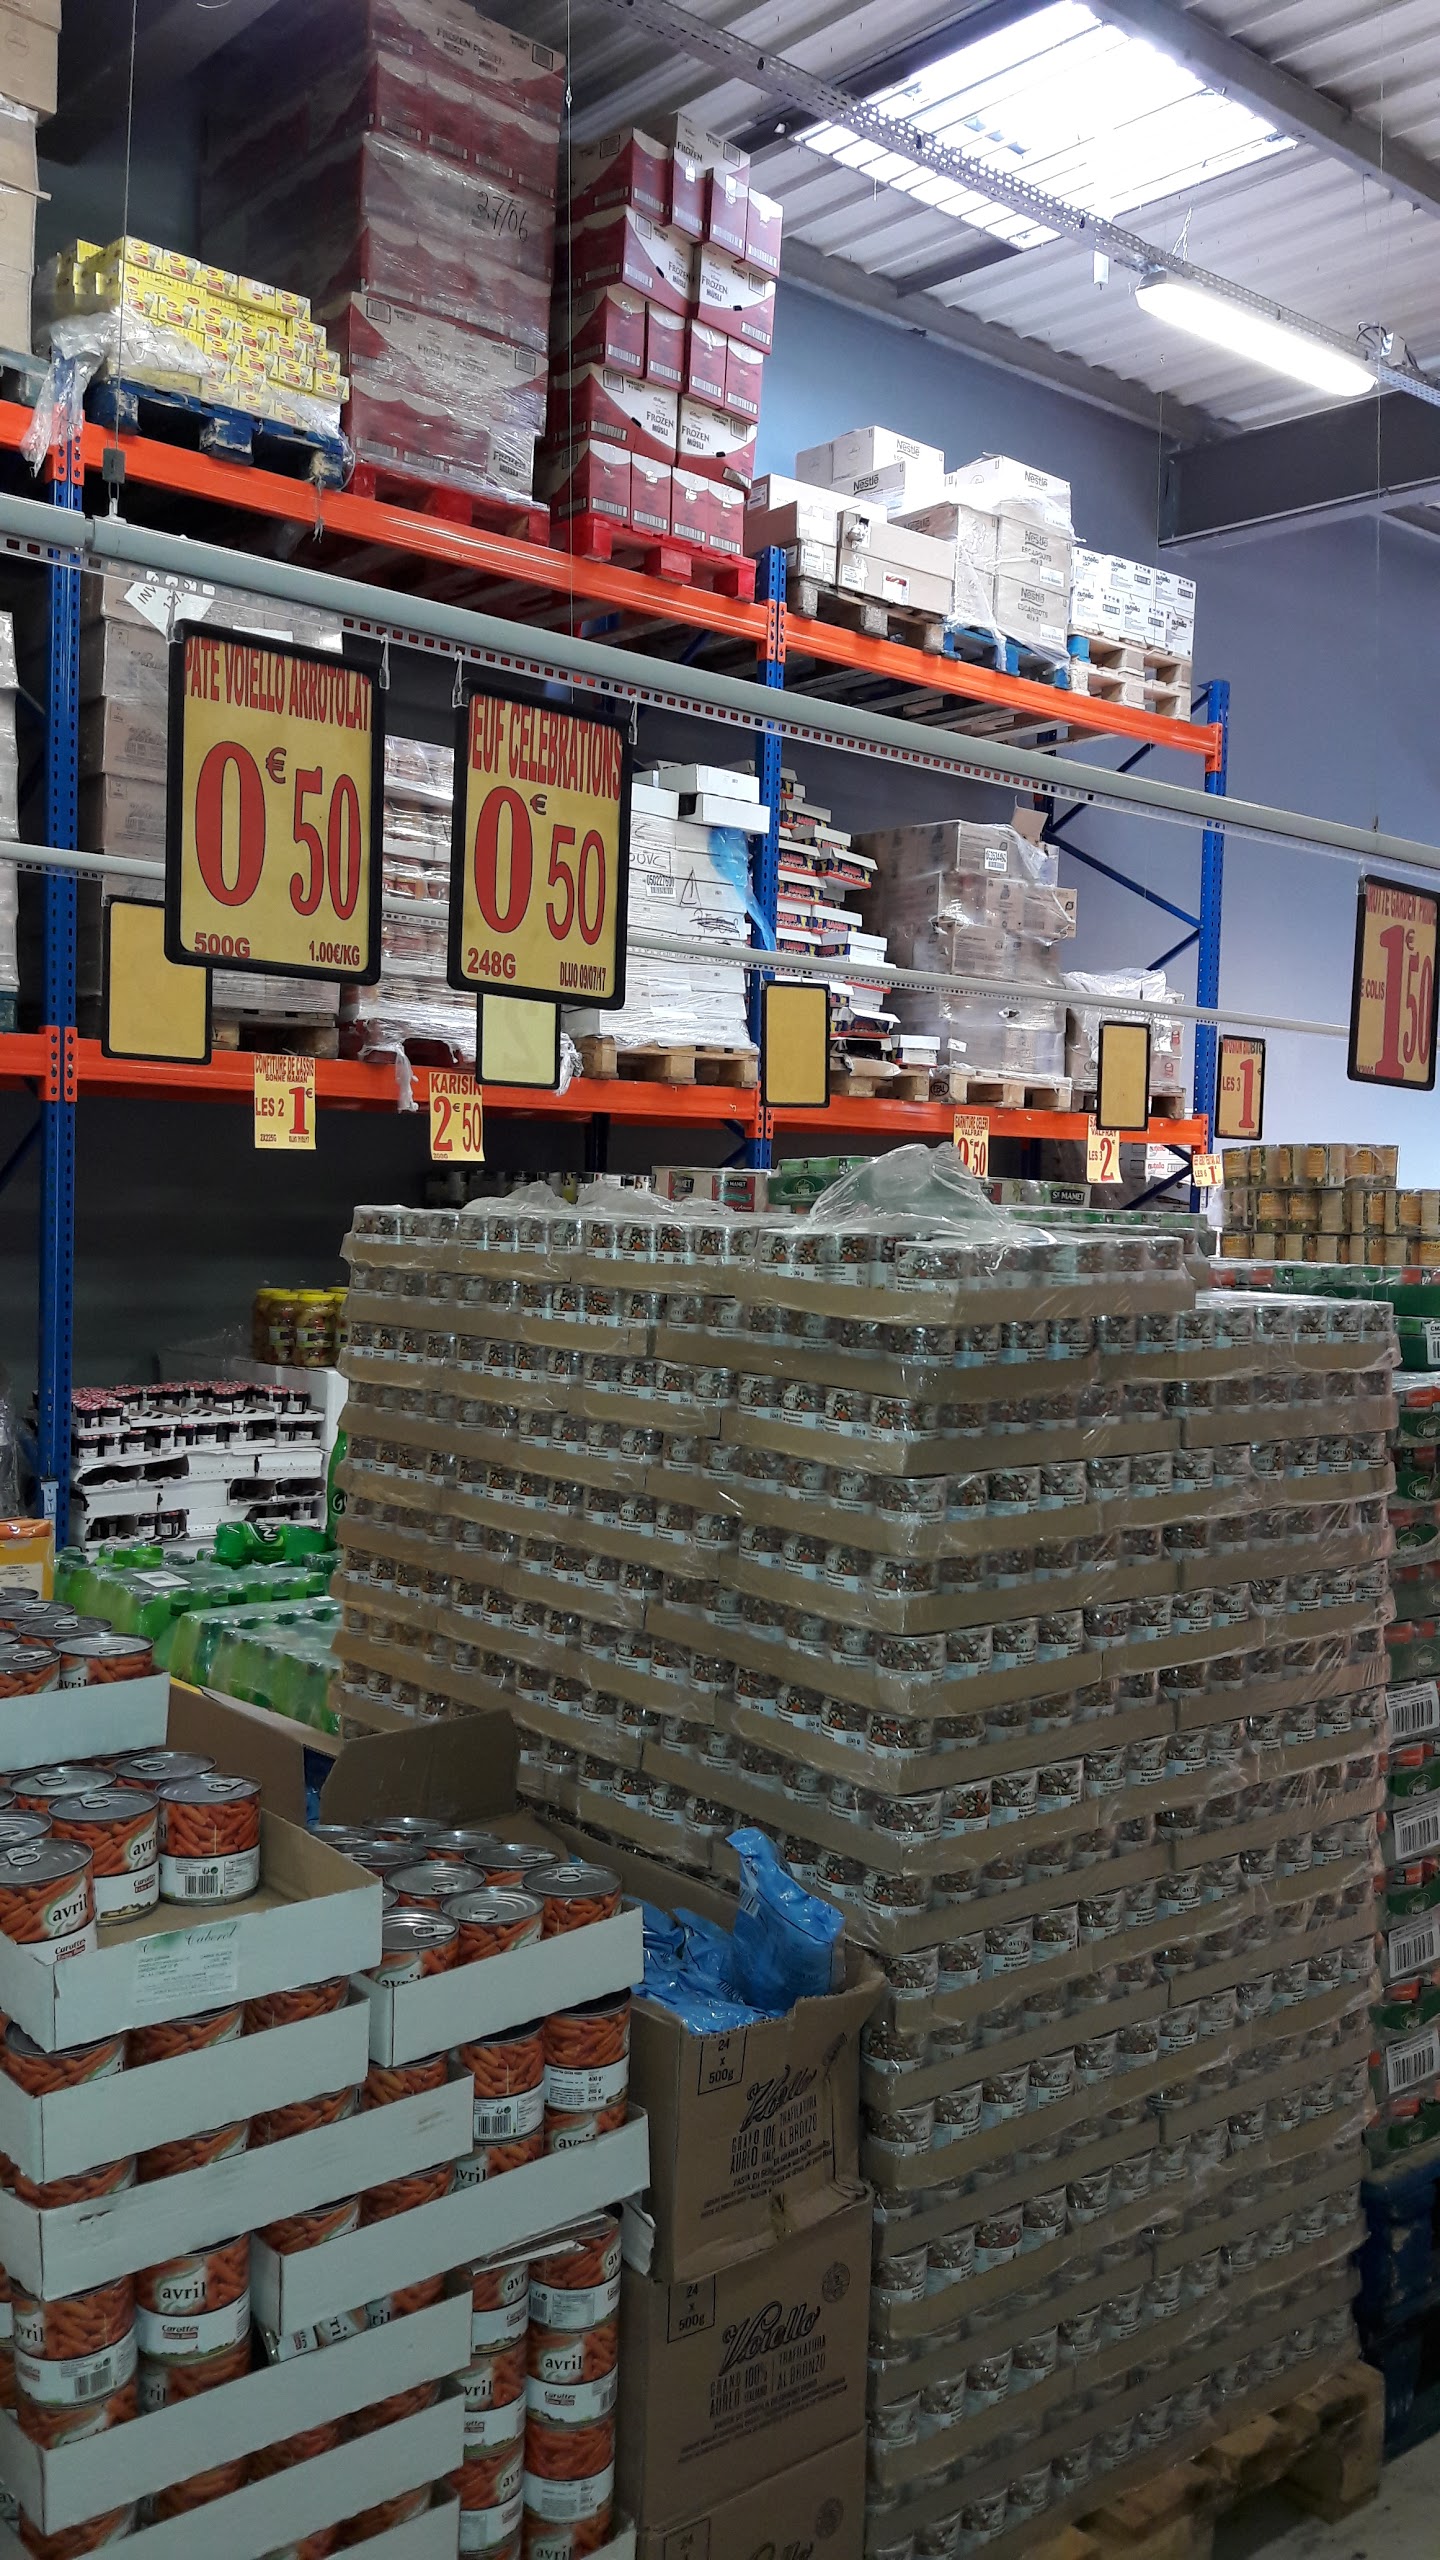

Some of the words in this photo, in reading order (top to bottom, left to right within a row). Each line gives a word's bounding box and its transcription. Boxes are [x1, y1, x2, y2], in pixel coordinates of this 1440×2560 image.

[477, 191, 528, 240] 27/06
[701, 274, 728, 295] FROZEN
[646, 411, 675, 430] FROZEN
[652, 423, 669, 437] MÜSLI
[681, 424, 710, 443] FROZEN
[687, 438, 704, 450] MÜSLI
[184, 635, 220, 702] PATE
[224, 641, 285, 715] VOIELLO
[288, 653, 371, 732] ARROTOLAT
[468, 693, 504, 775] EUF
[509, 702, 623, 801] CELEBRATIONS
[194, 932, 250, 959] 500G
[309, 939, 360, 967] 1.00€/KG
[467, 948, 516, 979] 248G
[560, 961, 578, 988] DLUO
[1365, 978, 1385, 1000] COLIS
[265, 1073, 286, 1083] BONNE
[286, 1074, 308, 1084] MAMAN
[1222, 1075, 1235, 1091] LES
[1236, 1076, 1241, 1091] 3
[255, 1097, 275, 1117] LES
[277, 1099, 285, 1117] 2
[961, 1129, 983, 1137] VALFRAY
[1089, 1150, 1098, 1160] LES
[1060, 1191, 1085, 1201] MAMET
[52, 1894, 89, 1922] avril
[55, 1938, 86, 1955] Carottes
[718, 2039, 730, 2051] 24
[708, 2070, 734, 2085] 500g
[162, 2281, 206, 2300] avril
[687, 2283, 698, 2297] 24
[161, 2323, 200, 2334] Carottes
[678, 2314, 705, 2332] 500g
[718, 2300, 820, 2377] Voiello
[545, 2346, 582, 2372] avril
[464, 2374, 493, 2397] vril
